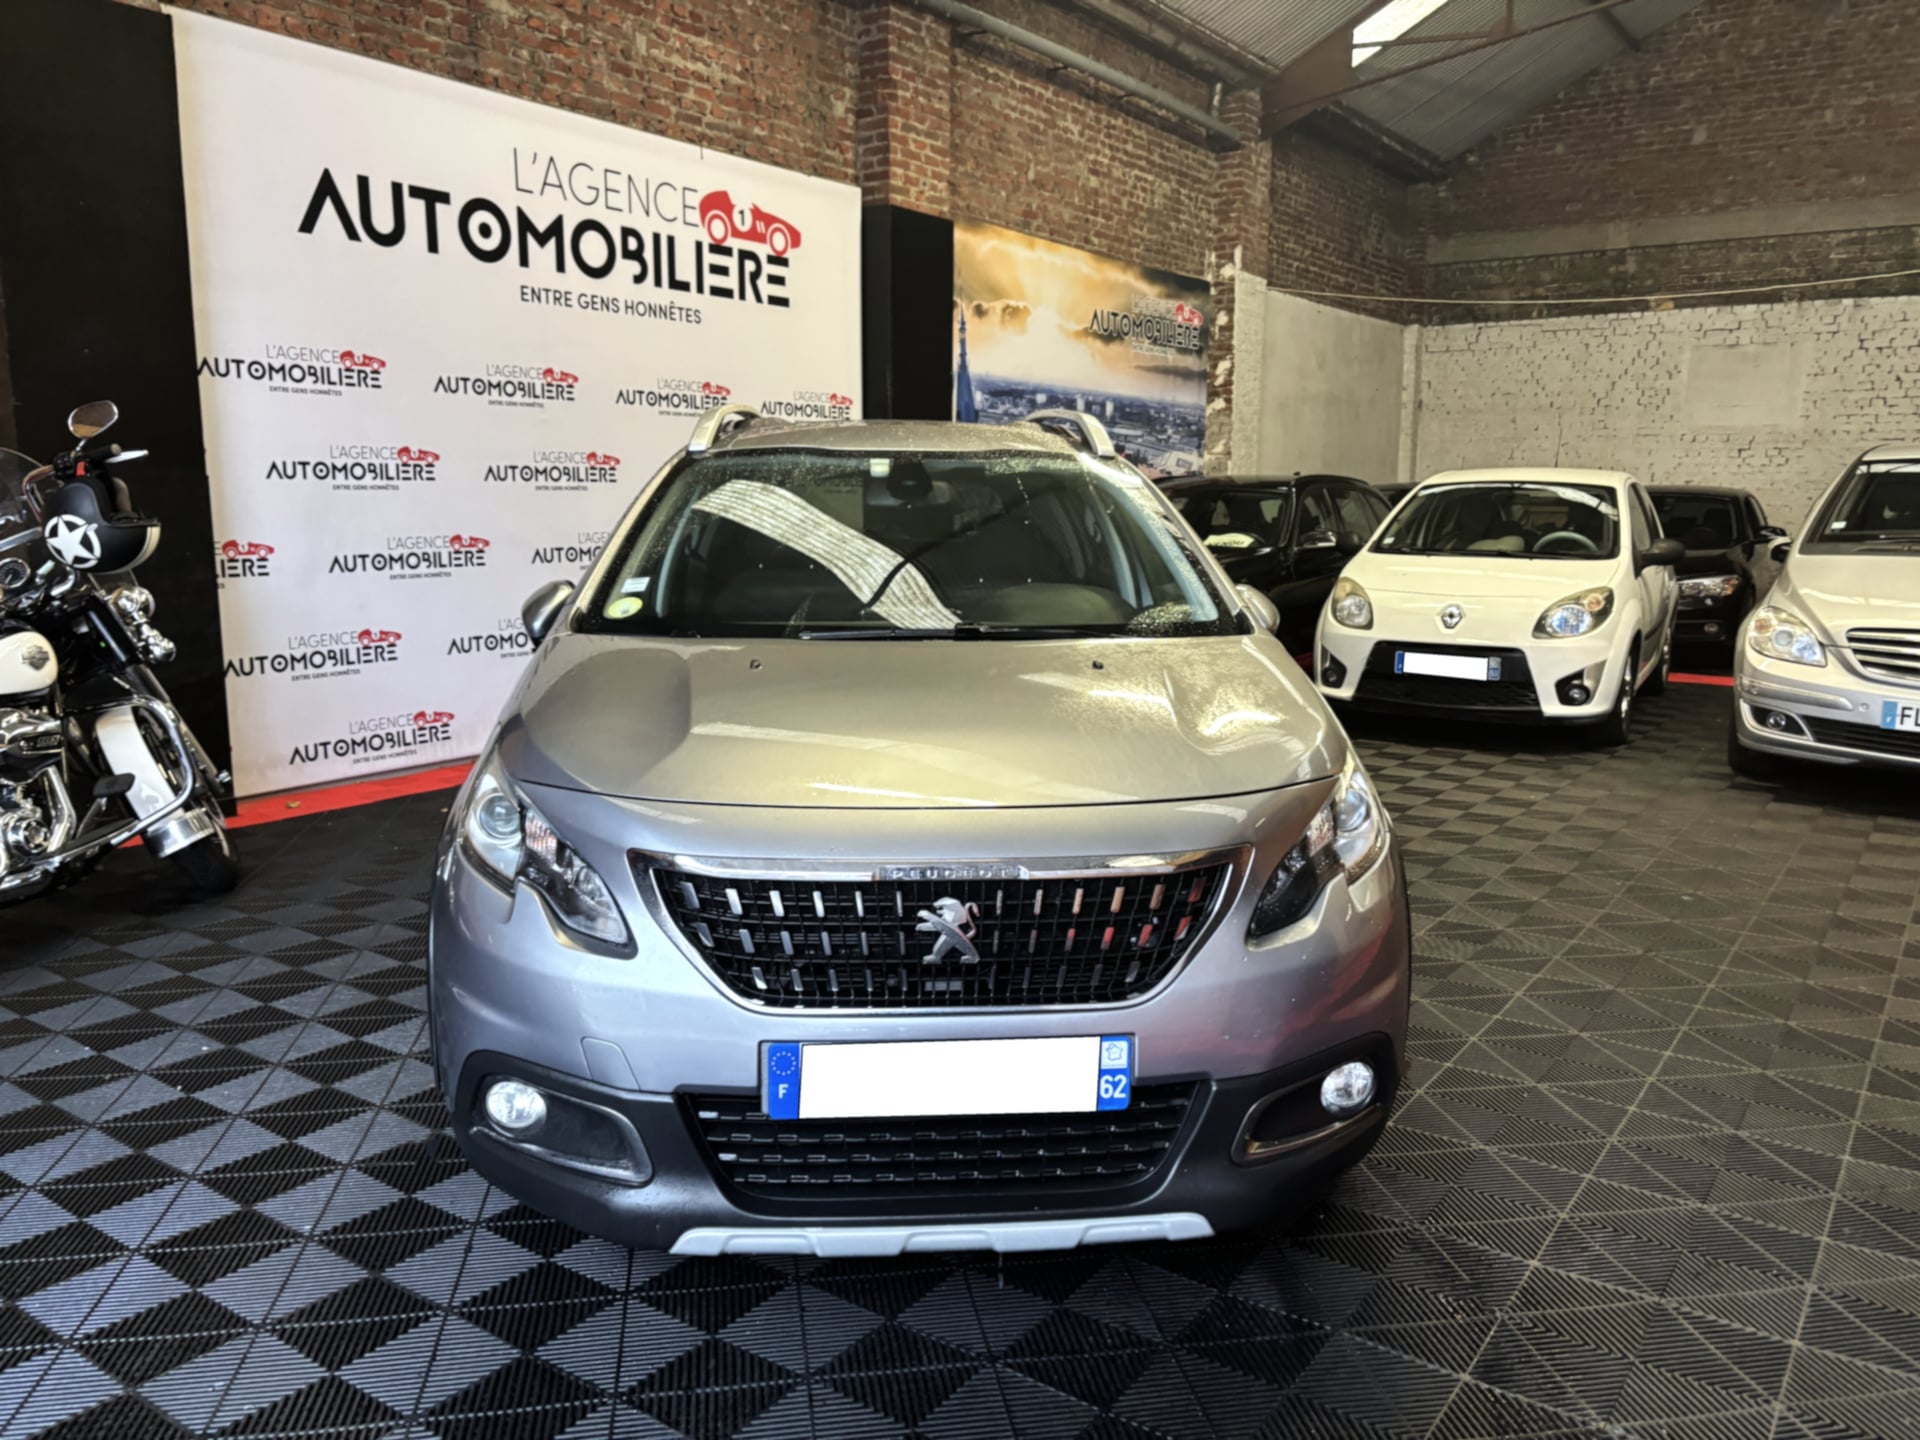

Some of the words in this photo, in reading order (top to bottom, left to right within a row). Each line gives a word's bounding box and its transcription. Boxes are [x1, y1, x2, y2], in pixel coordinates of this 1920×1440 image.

[513, 147, 699, 227] L'AGENCE
[520, 285, 573, 309] ENTRE
[577, 292, 620, 314] GENS
[624, 298, 702, 324] HONNÊTES
[266, 343, 340, 365] L'AGENCE
[486, 363, 543, 380] L'AGENCE
[657, 378, 703, 393] L'AGENCE
[329, 445, 398, 460] L'AGENCE
[533, 451, 587, 464] L'AGENCE
[387, 535, 450, 550] L'AGENCE
[288, 630, 358, 650] L'AGENCE
[349, 713, 414, 735] L'AGENCE
[778, 1083, 789, 1099] F
[1100, 1074, 1127, 1099] 62
